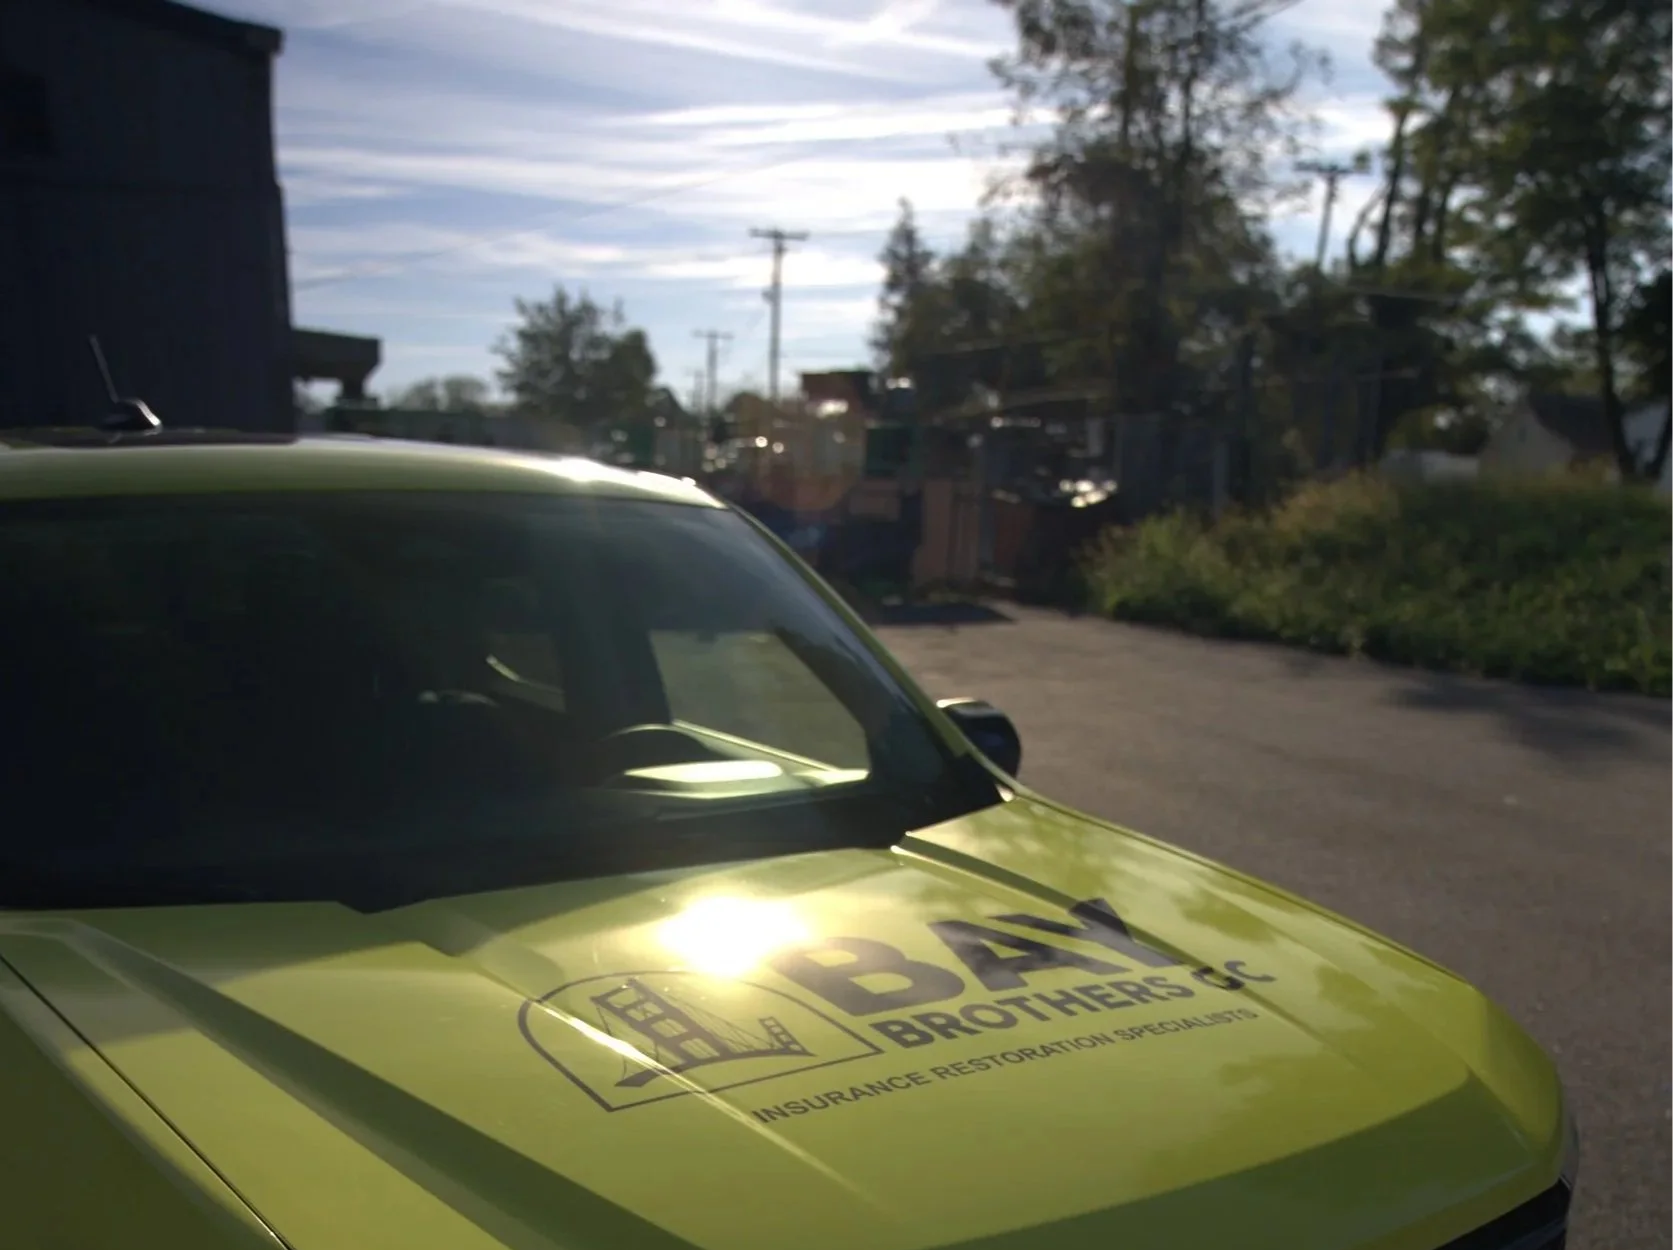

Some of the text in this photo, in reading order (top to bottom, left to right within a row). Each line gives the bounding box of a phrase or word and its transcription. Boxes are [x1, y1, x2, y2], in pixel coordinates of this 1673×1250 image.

[769, 898, 1186, 1016] BAY
[868, 976, 1194, 1048] BROTHERS
[753, 1008, 1259, 1123] INSURANCE RESTORATION SPECIALISTS
